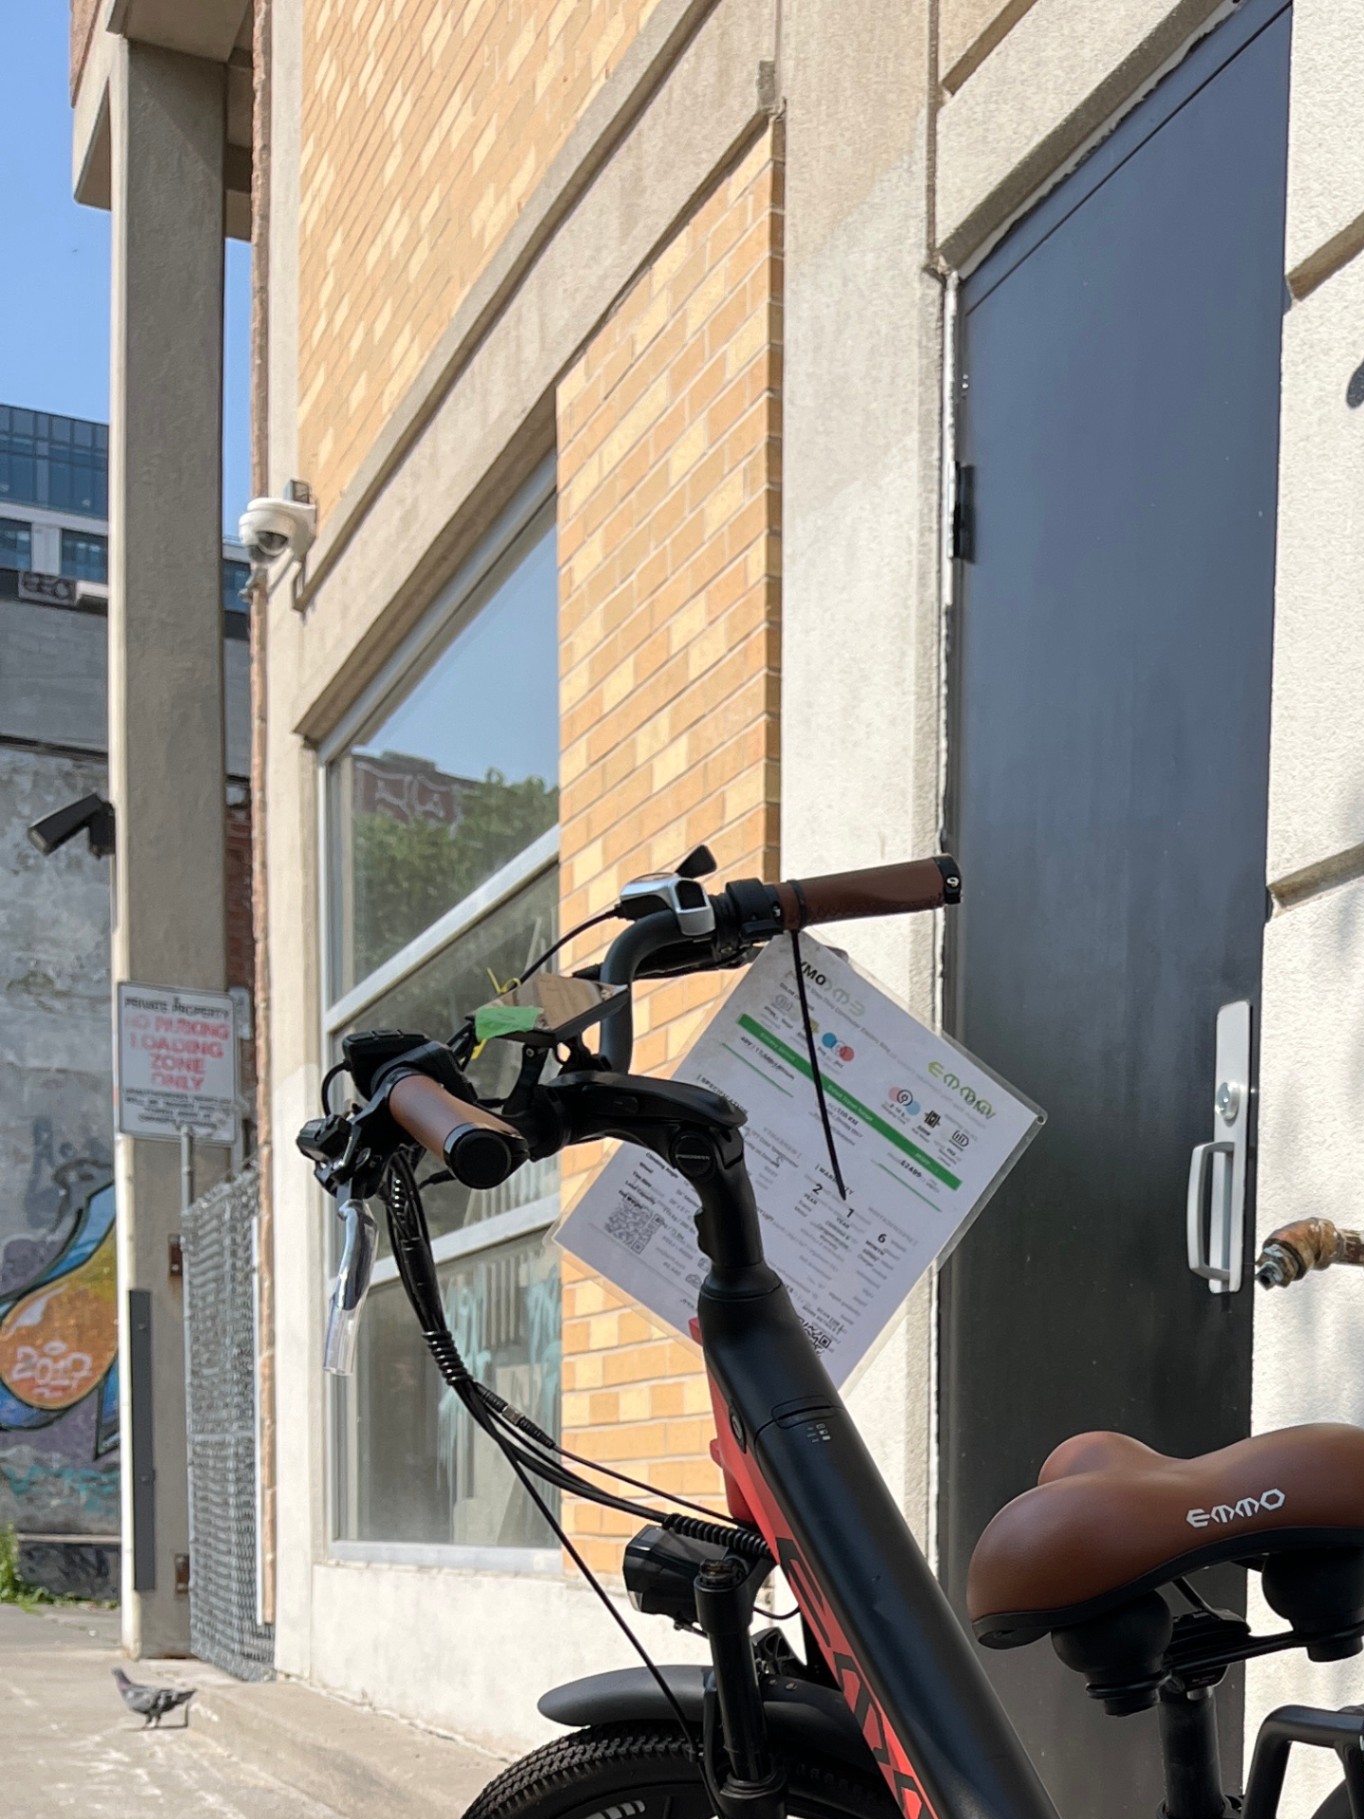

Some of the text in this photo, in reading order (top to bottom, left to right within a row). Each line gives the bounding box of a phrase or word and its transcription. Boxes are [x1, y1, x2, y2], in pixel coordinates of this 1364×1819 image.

[812, 1183, 823, 1195] 2
[845, 1207, 855, 1218] 1
[877, 1232, 888, 1244] 6
